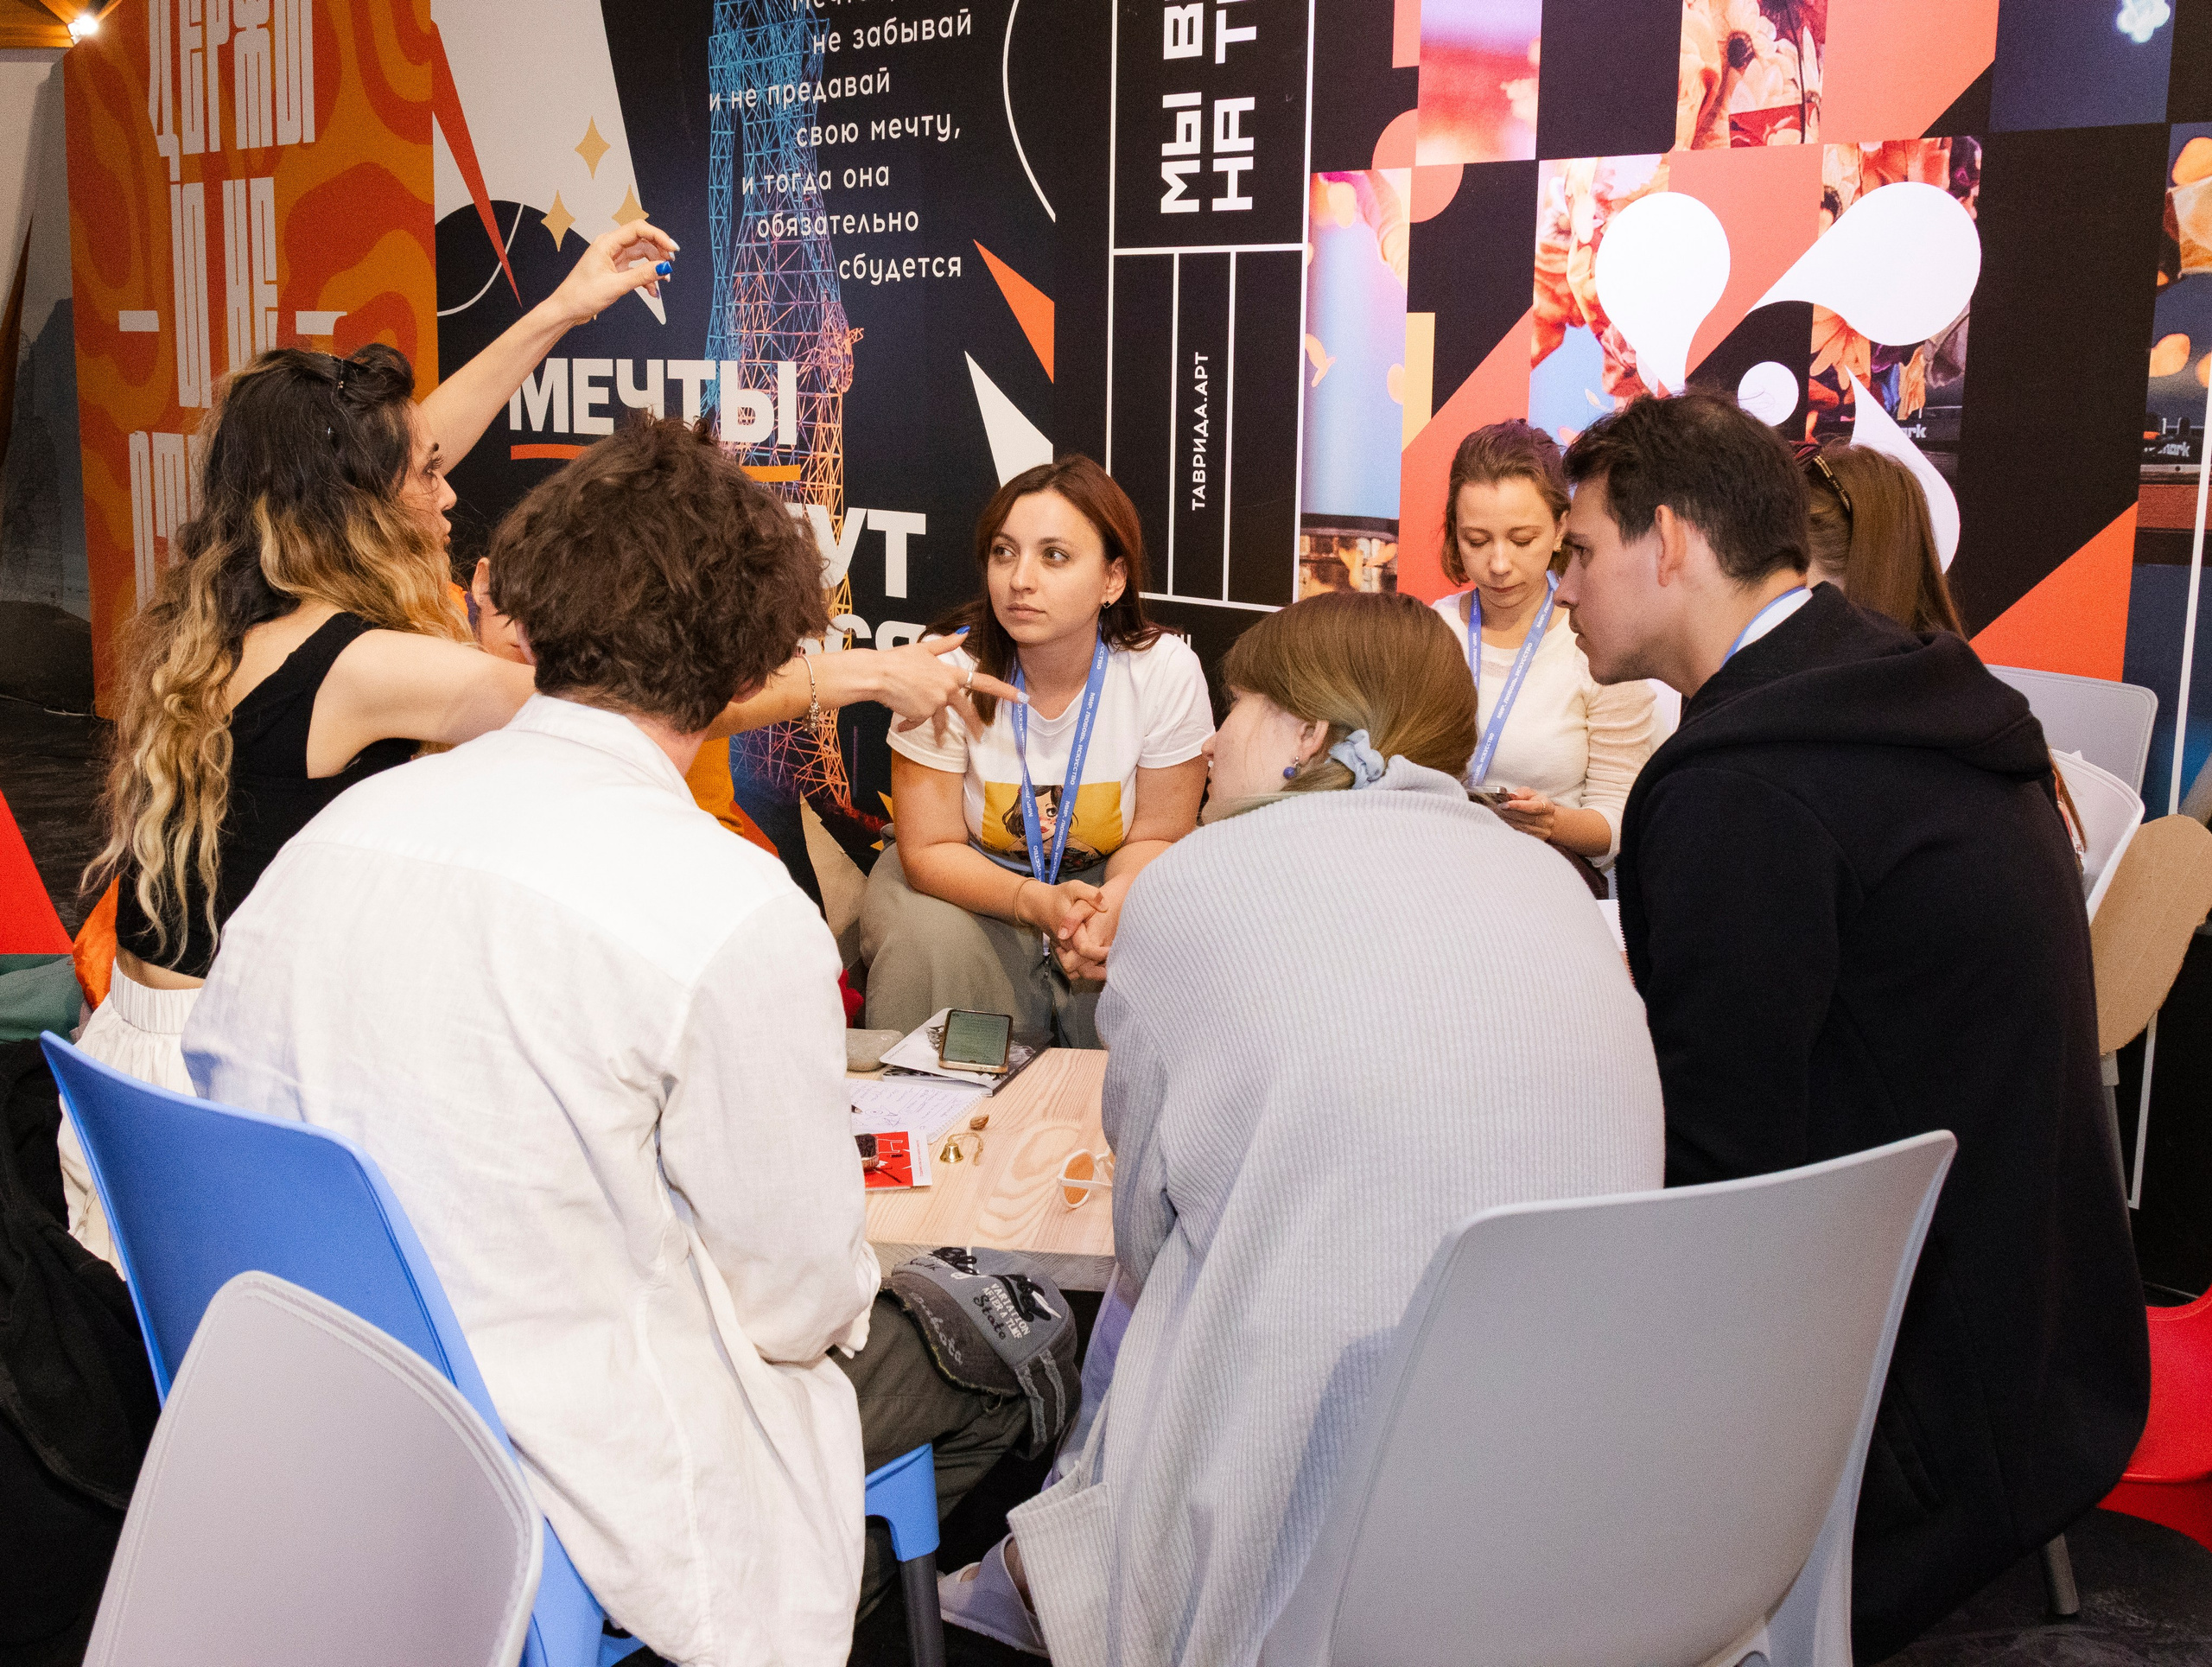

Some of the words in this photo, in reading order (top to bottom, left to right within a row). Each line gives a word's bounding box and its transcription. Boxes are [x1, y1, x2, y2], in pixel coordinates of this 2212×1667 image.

[813, 32, 841, 54] не
[853, 8, 971, 49] забывай
[709, 92, 721, 111] и
[731, 88, 757, 109] не
[768, 67, 890, 110] предавай
[796, 123, 859, 147] свою
[871, 113, 961, 142] мечту,
[1160, 92, 1202, 213] МЫ
[1212, 97, 1255, 211] НА
[742, 175, 753, 194] и
[764, 169, 832, 194] тогда
[842, 166, 889, 188] она
[757, 211, 919, 238] обязательно
[839, 252, 962, 285] сбудется
[509, 358, 798, 445] МЕЧТЫ
[1192, 352, 1209, 511] ТАВРИДА.АРТ
[1070, 744, 1084, 786] ИСКУССТВО
[973, 1294, 1006, 1339] State
[990, 1283, 1030, 1335] VARIATION
